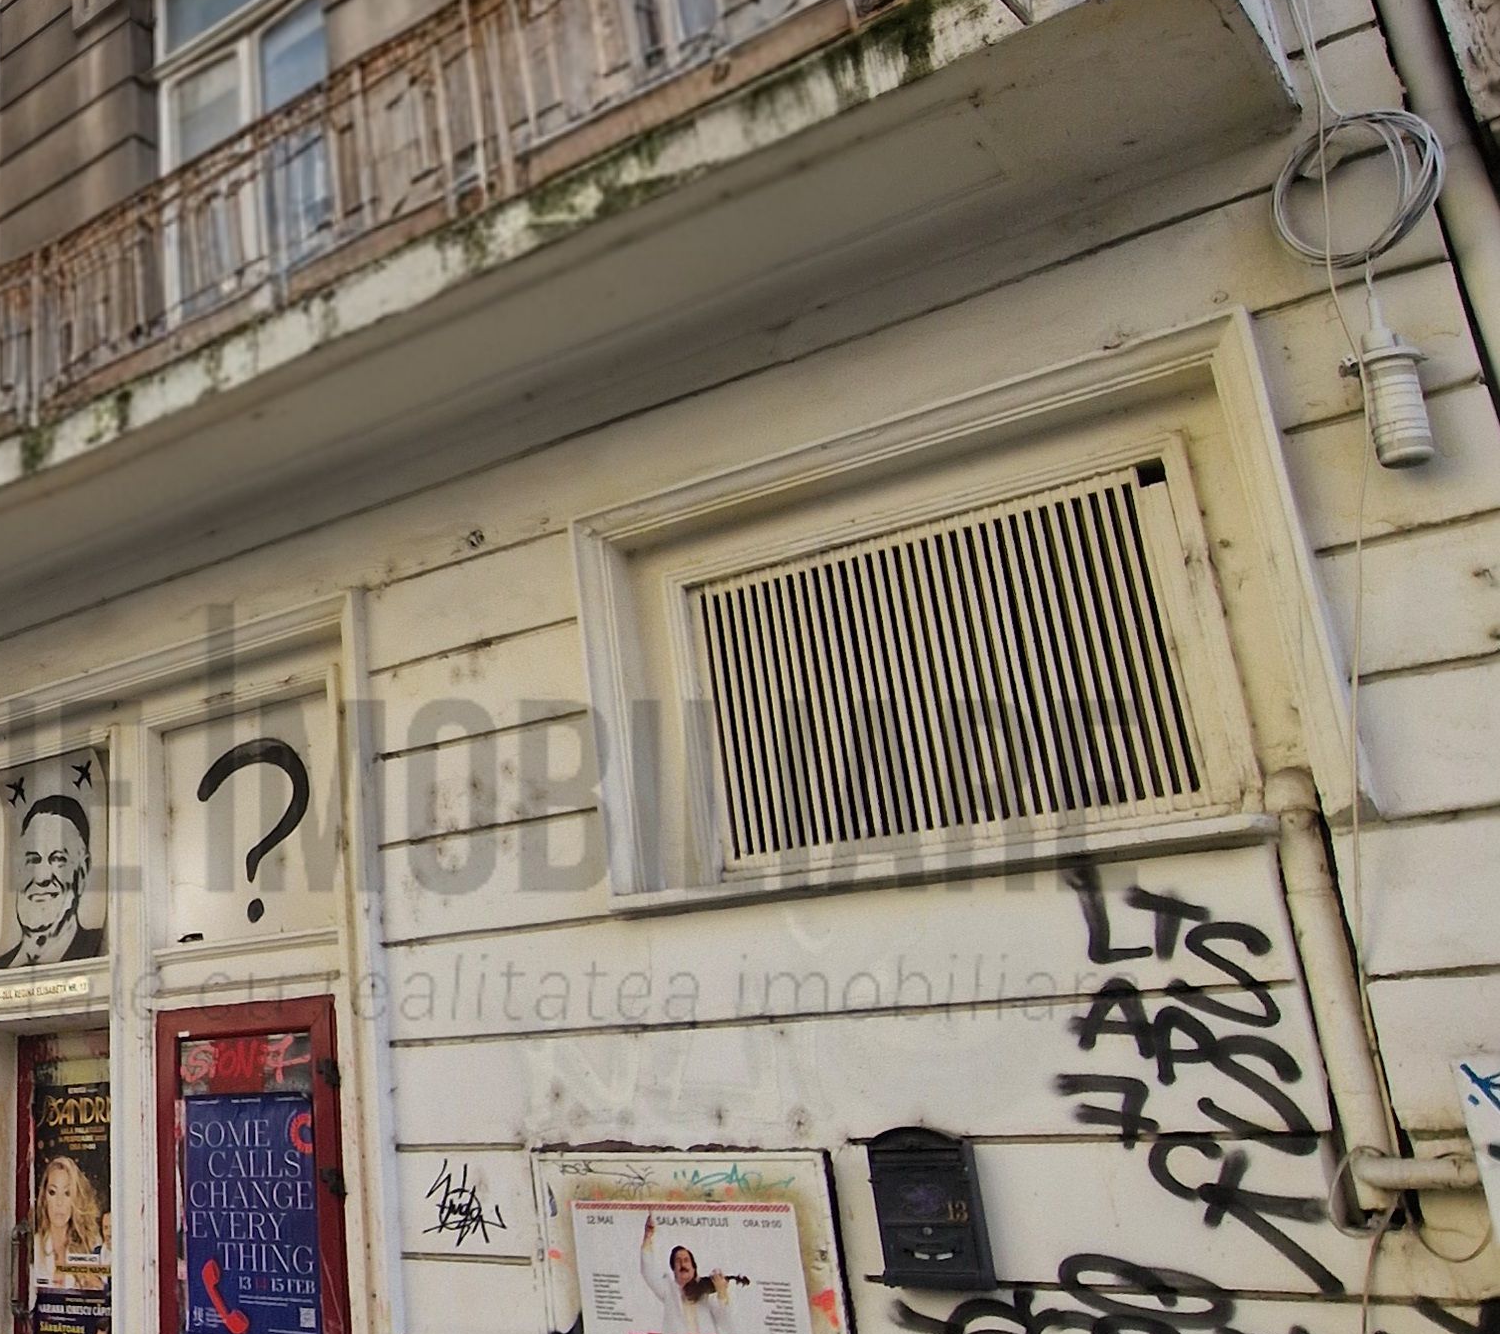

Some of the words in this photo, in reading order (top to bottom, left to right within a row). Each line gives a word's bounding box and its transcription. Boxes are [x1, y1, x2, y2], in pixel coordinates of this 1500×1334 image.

[190, 1120, 270, 1148] SOME
[208, 1150, 301, 1178] CALLS
[190, 1181, 314, 1210] CHANGE
[190, 1211, 286, 1241] EVERY
[598, 1215, 614, 1225] MAI
[656, 1216, 679, 1226] SALA
[680, 1216, 729, 1228] PALATULUI
[217, 1242, 314, 1275] THING
[238, 1276, 252, 1290] 13
[271, 1278, 285, 1292] 15
[287, 1278, 316, 1294] FEB
